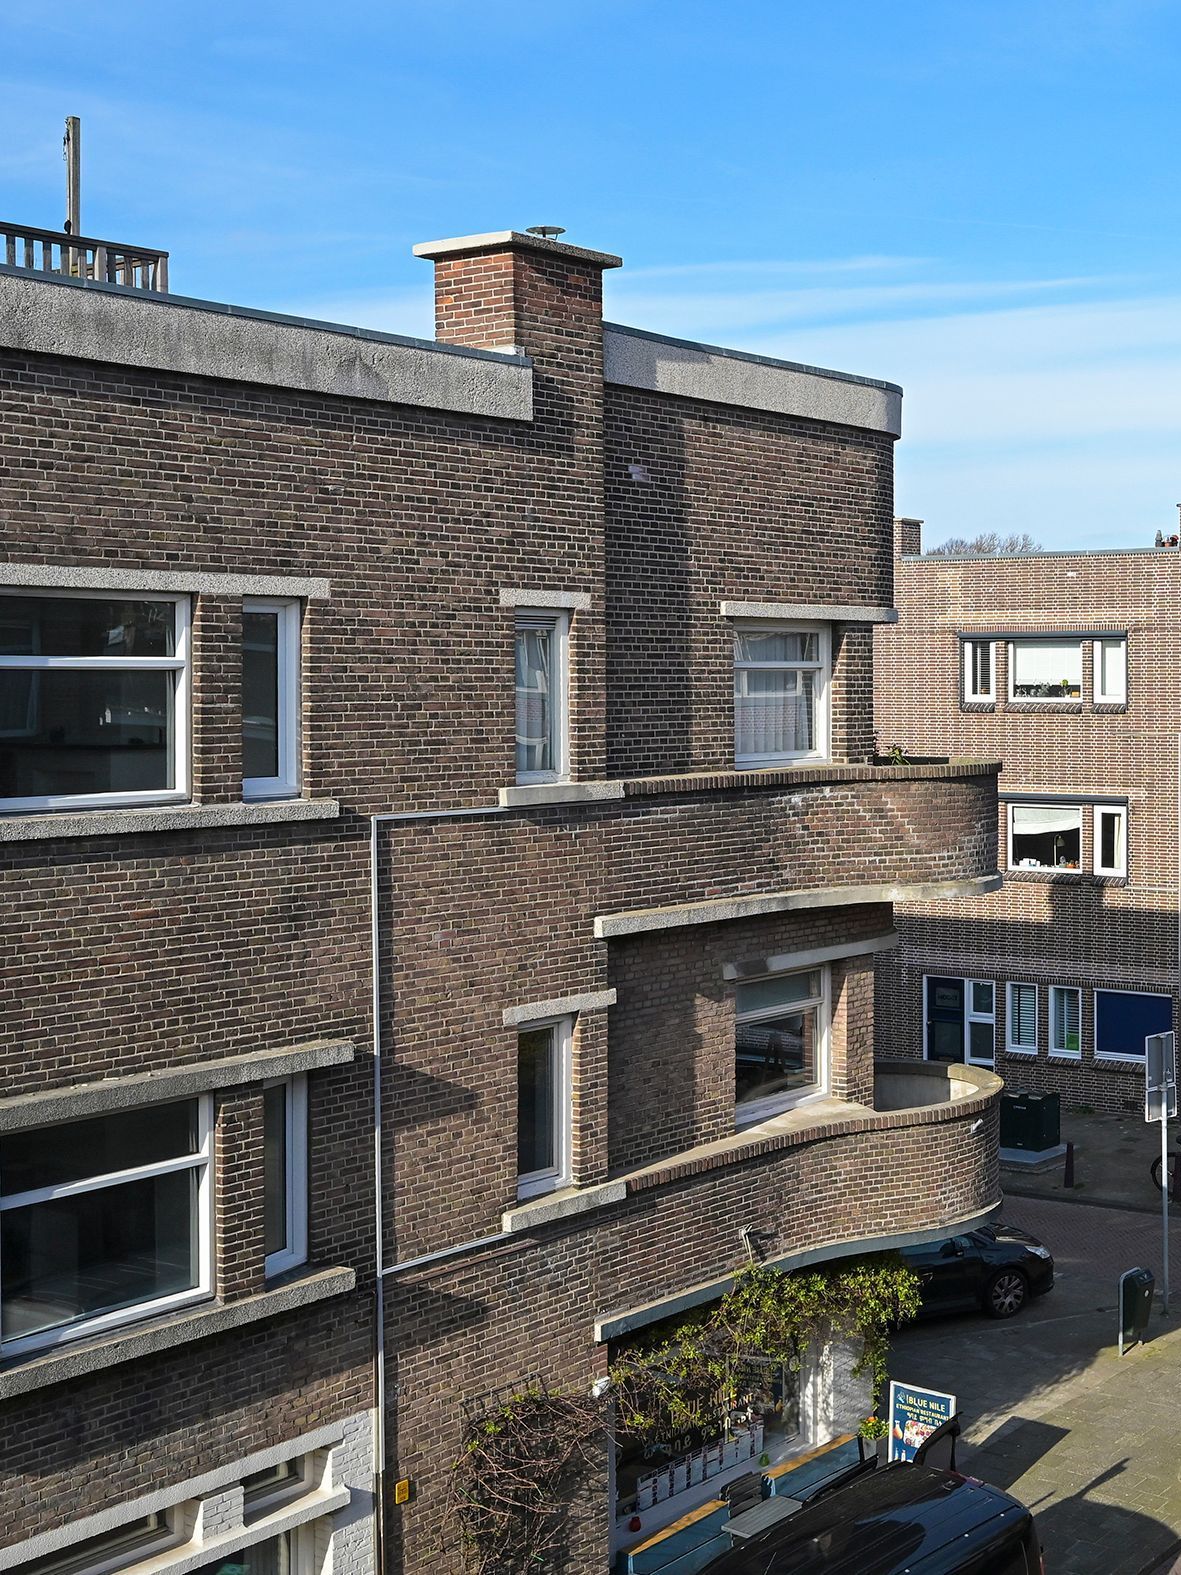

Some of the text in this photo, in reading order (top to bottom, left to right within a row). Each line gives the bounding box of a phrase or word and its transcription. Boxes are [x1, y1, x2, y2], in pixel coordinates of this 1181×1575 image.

[908, 1396, 946, 1413] BLUE NILE
[920, 1409, 950, 1422] RESTAURANT
